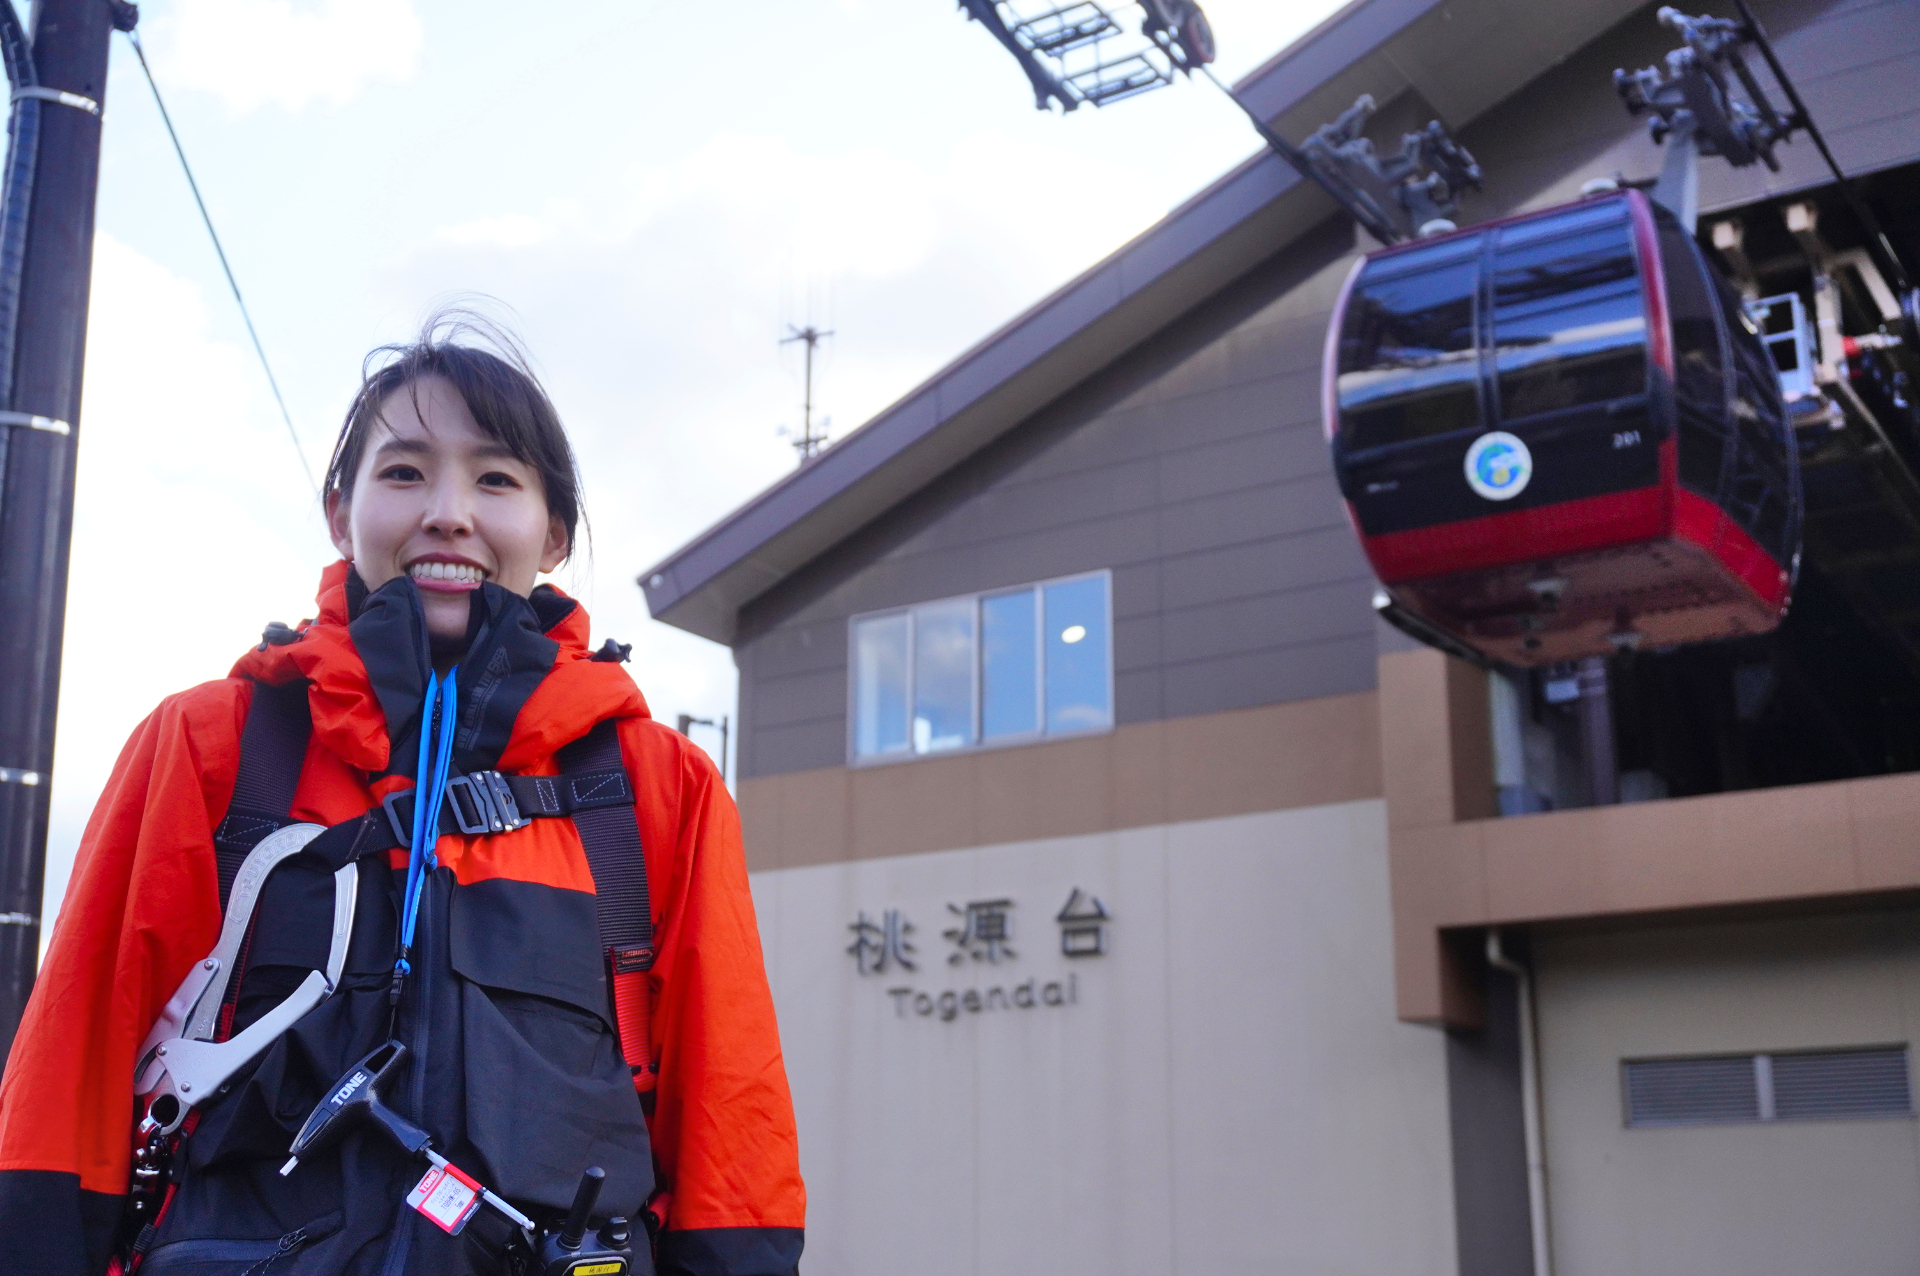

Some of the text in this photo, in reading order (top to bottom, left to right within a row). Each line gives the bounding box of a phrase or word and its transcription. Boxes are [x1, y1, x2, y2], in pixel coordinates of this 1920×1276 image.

[846, 886, 1111, 975] 桃源台
[887, 973, 1079, 1021] Togendai
[330, 1071, 368, 1106] TONE
[419, 1170, 439, 1192] TONE
